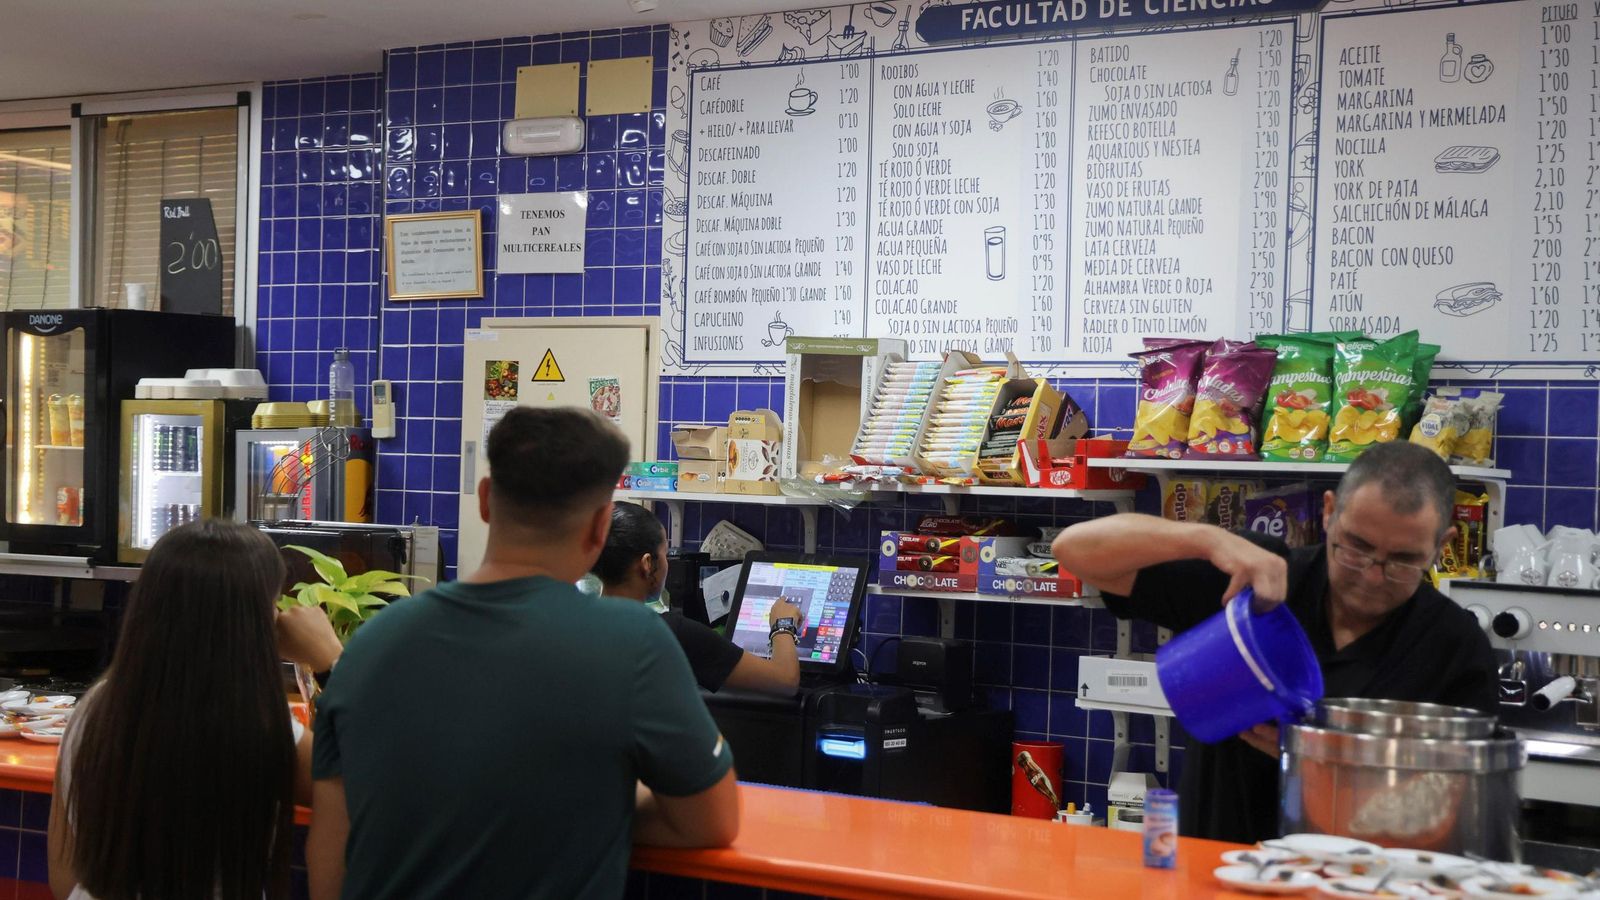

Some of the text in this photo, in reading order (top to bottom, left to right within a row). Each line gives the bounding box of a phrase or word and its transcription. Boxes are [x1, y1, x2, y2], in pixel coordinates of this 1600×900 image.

[961, 0, 1087, 31] FACULTAD
[1099, 0, 1132, 18] DE
[1542, 3, 1578, 23] PITUFO
[1541, 24, 1570, 45] 1'00
[1090, 45, 1129, 63] BATIDO
[1339, 45, 1381, 66] ACEITE
[841, 63, 859, 79] 1'00
[881, 64, 918, 80] ROOIBOS
[1090, 65, 1147, 83] CHOCOLATE
[1339, 68, 1385, 89] TOMATE
[701, 74, 721, 91] CAFÉ
[894, 79, 975, 99] CON AGUA Y LECHE
[1105, 80, 1212, 103] SOJA O SIN LACTOSA
[700, 98, 744, 115] CAFÉDOBLE
[1037, 91, 1057, 107] 1'60
[1257, 90, 1279, 108] 1'20
[1337, 89, 1413, 110] MARGARINA
[1539, 96, 1567, 116] 1'50
[893, 102, 942, 119] SOLO LECHE
[1088, 101, 1177, 122] ZUMO ENVASADO
[1337, 105, 1506, 133] MARGARINA Y MERMELADA
[893, 120, 971, 138] CON AGUA Y SOJA
[1088, 121, 1175, 141] REFESCO BOTELLA
[699, 146, 760, 162] DESCAFEINADO
[838, 138, 858, 153] 1'00
[893, 142, 938, 159] SOLO SOJA
[1088, 139, 1200, 161] AQUARIOUS Y NESTEA
[1336, 137, 1386, 156] NOCILLA
[880, 157, 951, 178] TÉ ROJO Ó VERDE
[1035, 153, 1056, 169] 1'00
[1256, 151, 1278, 168] 1'20
[1335, 159, 1364, 178] YORK
[698, 170, 756, 186] DESCAF. DOBLE
[1087, 161, 1142, 180] BIOFRUTAS
[1087, 179, 1170, 198] VASO DE FRUTAS
[1334, 179, 1418, 200] YORK DE PATA
[697, 192, 773, 212] DESCAF. MÁQUINA
[1086, 198, 1202, 218] ZUMO NATURAL GRANDE
[1333, 196, 1488, 223] SALCHICHÓN DE MÁLAGA
[520, 209, 565, 220] TENEMOS
[837, 212, 855, 227] 1'30
[1034, 214, 1055, 230] 1'10
[1253, 212, 1276, 229] 1'30
[532, 226, 551, 237] PAN
[696, 216, 782, 235] DESCAF. MÁQUINA DOBLE
[878, 219, 943, 236] AGUA GRANDE
[1085, 217, 1203, 238] ZUMO NATURAL PEQUEÑO
[1332, 226, 1374, 245] BACON
[502, 242, 582, 254] MULTICEREALES
[877, 237, 947, 257] AGUA PEQUEÑA
[1085, 239, 1155, 256] LATA CERVEZA
[1331, 246, 1453, 268] BACON CON QUESO
[877, 259, 942, 275] VASO DE LECHE
[1085, 258, 1180, 276] MEDIA DE CERVEZA
[1532, 263, 1561, 282] 1'20
[876, 279, 918, 295] COLACAO
[1033, 275, 1053, 291] 1'20
[1085, 277, 1212, 295] ALHAMBRA VERDE O ROJA
[1251, 272, 1274, 288] 2'30
[1330, 269, 1357, 290] PATÉ
[695, 286, 826, 306] CAFÉ BOMBÓN PEQUEÑO 1'30 GRANDE
[1329, 292, 1362, 312] ATÚN
[875, 299, 957, 315] COLACAO GRANDE
[1083, 299, 1192, 315] CERVEZA SIN GLUTEN
[695, 312, 743, 327] CAPUCHINO
[834, 310, 851, 325] 1'40
[1329, 316, 1400, 334] SOBRASADA
[694, 336, 743, 351] INFUSIONES
[1032, 336, 1051, 351] 1'80
[1083, 337, 1112, 354] RIOJA
[1530, 334, 1557, 352] 1'25
